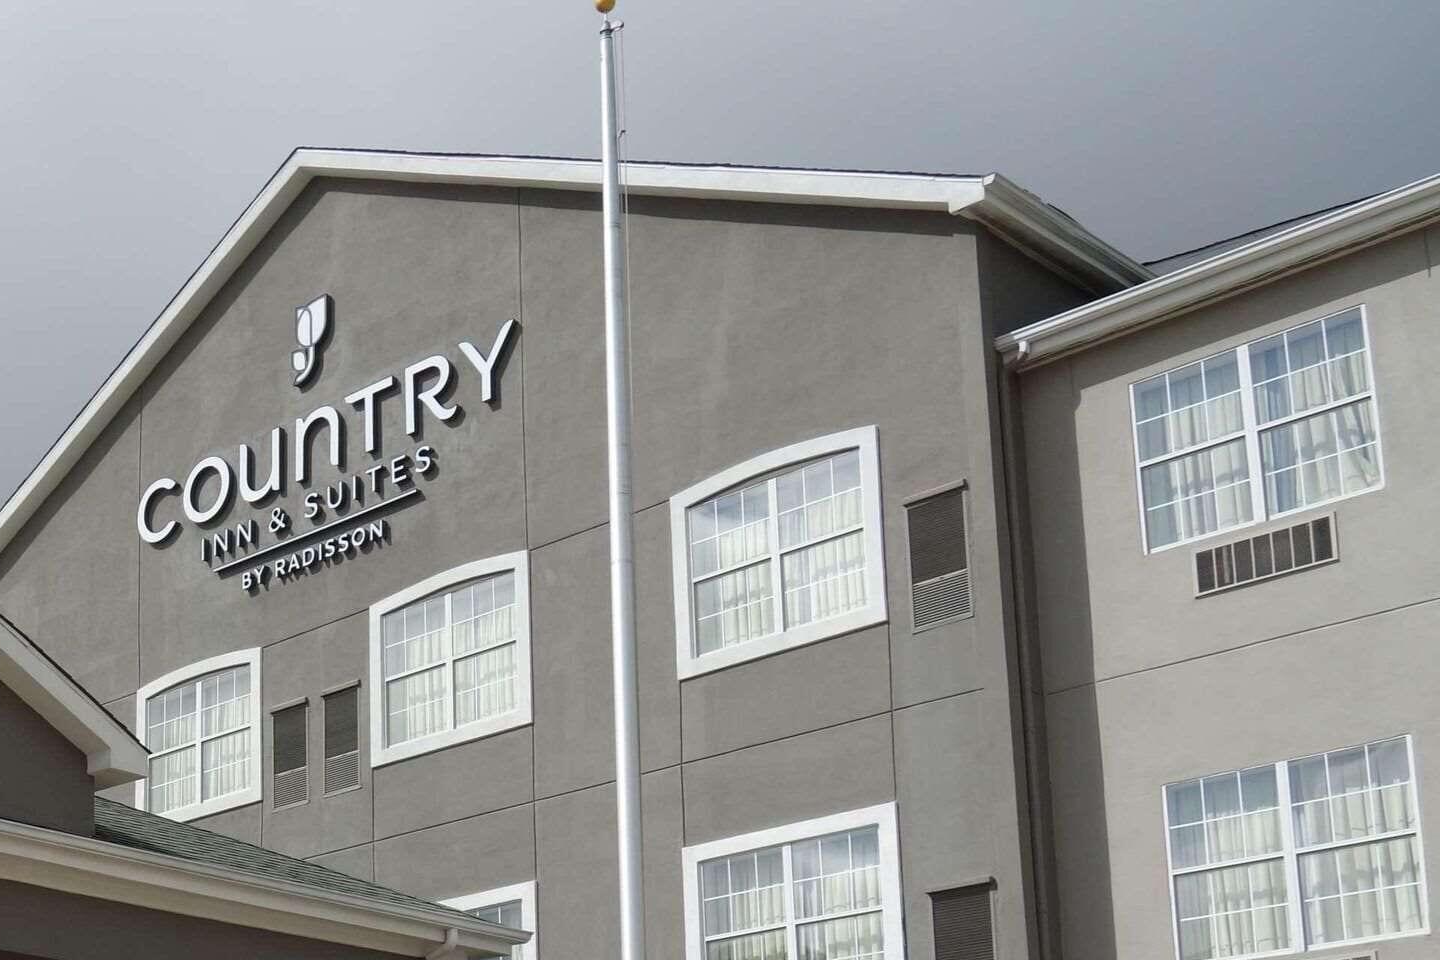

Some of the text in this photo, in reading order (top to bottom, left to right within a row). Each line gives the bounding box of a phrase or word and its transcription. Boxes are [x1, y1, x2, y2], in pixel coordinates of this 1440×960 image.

[201, 445, 434, 562] INN & SUITES
[241, 519, 385, 590] BY RADISSON
